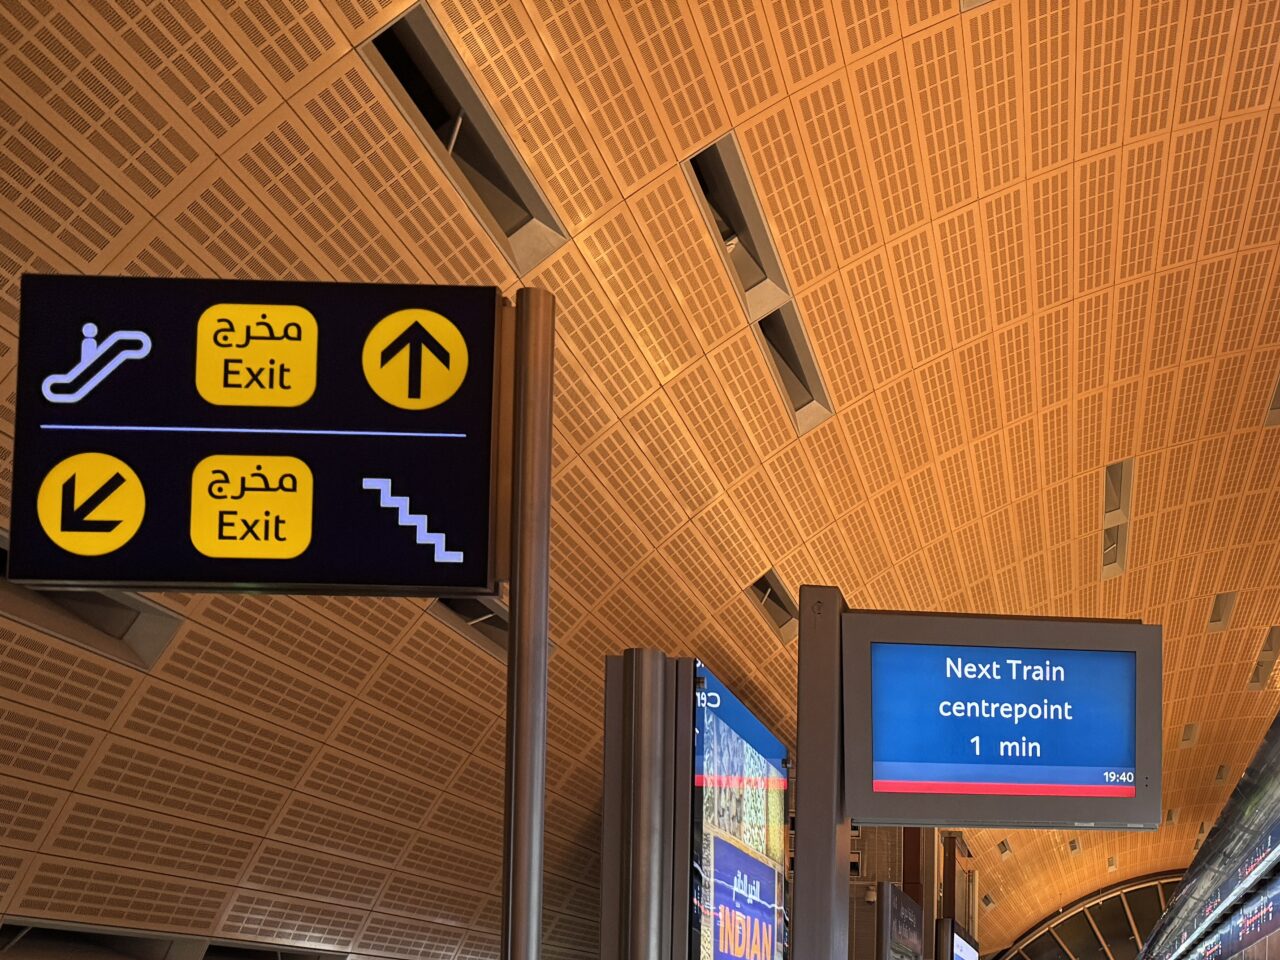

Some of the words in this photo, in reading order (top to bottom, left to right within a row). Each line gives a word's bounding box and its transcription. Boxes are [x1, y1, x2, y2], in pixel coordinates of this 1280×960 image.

[213, 312, 303, 348] مخرج
[222, 358, 291, 391] Exit
[208, 464, 298, 500] مخرج
[217, 510, 287, 542] Exit
[945, 657, 1000, 680] Next
[1006, 659, 1065, 682] Train
[938, 698, 1073, 724] centrepoint
[970, 736, 981, 755] 1
[999, 736, 1041, 757] min
[1103, 771, 1134, 783] 19:40
